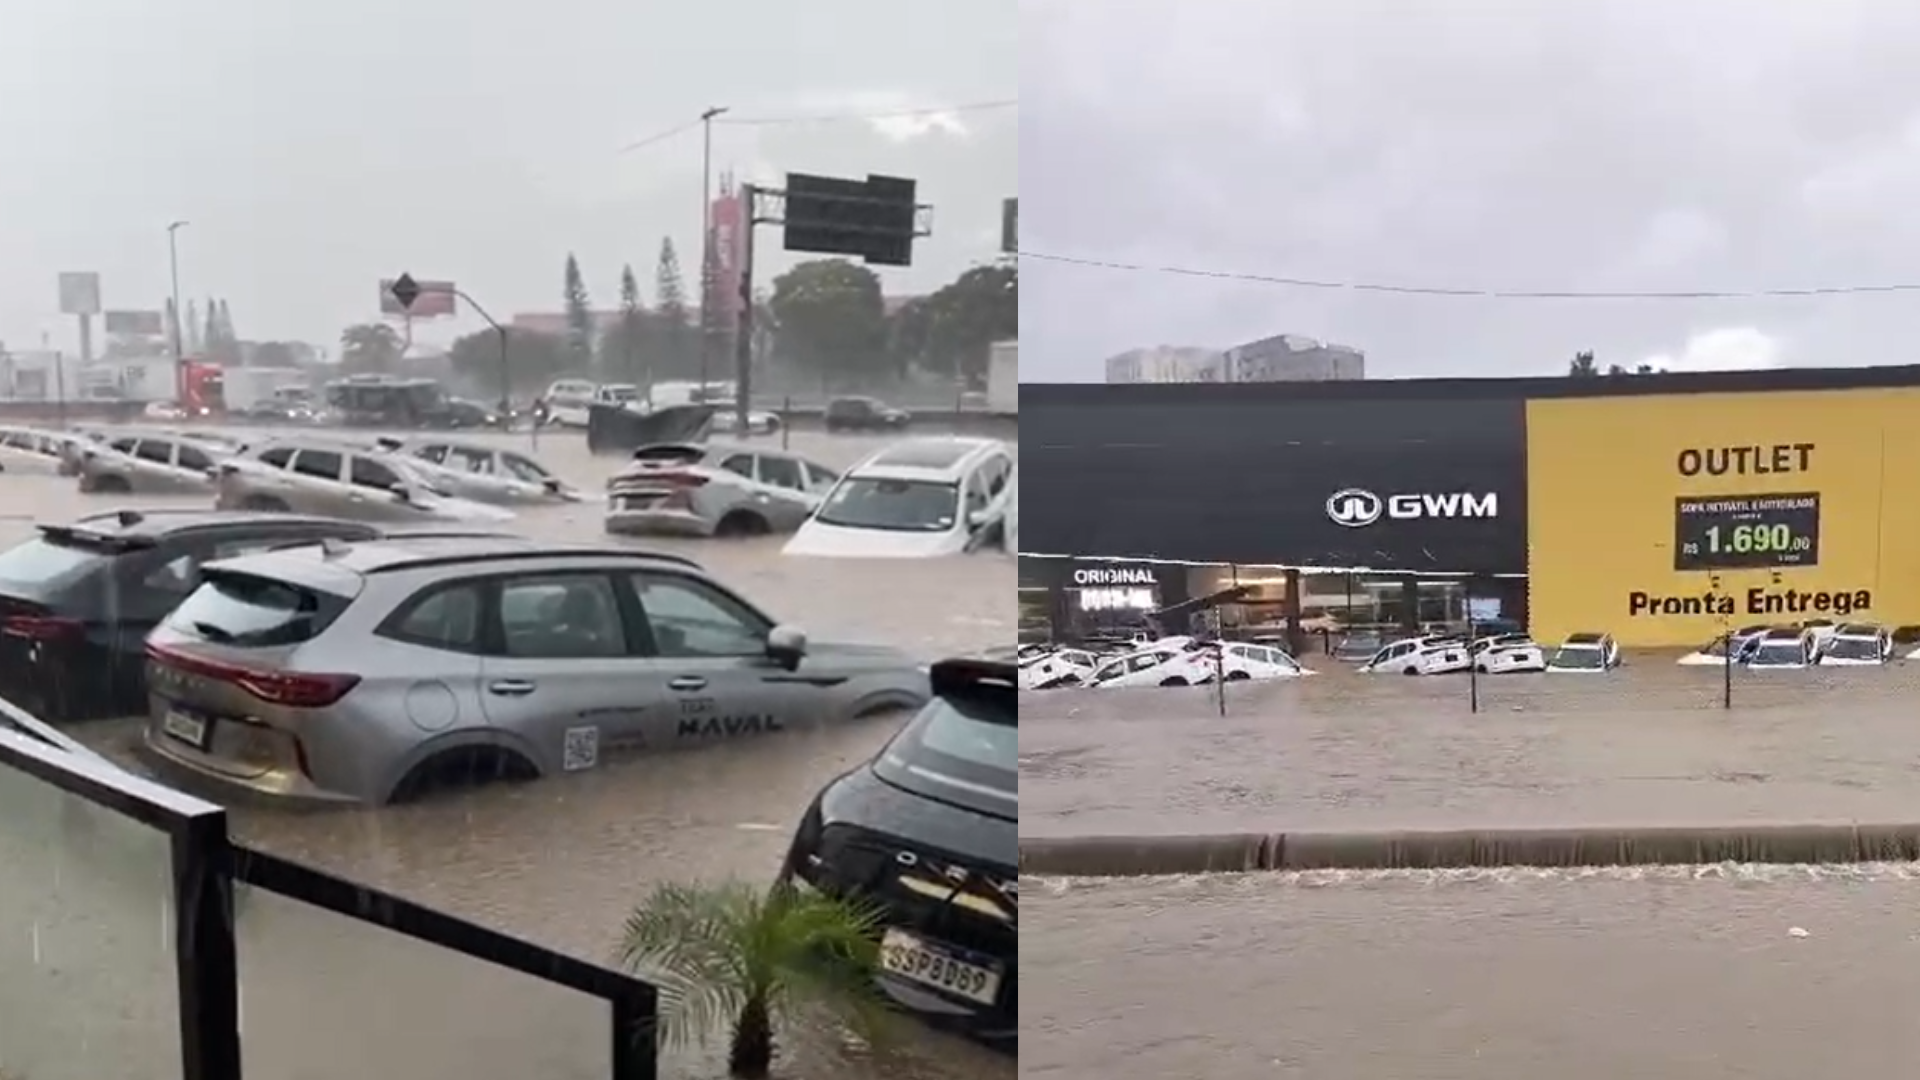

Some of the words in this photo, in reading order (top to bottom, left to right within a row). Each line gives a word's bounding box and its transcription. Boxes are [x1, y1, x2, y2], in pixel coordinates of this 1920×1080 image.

[1677, 443, 1815, 476] OUTLET
[1388, 493, 1498, 519] GWM
[1074, 569, 1158, 584] ORIGINAL
[1629, 591, 1735, 616] Pronta
[1746, 588, 1872, 616] Entrega
[678, 714, 783, 737] HAVAL
